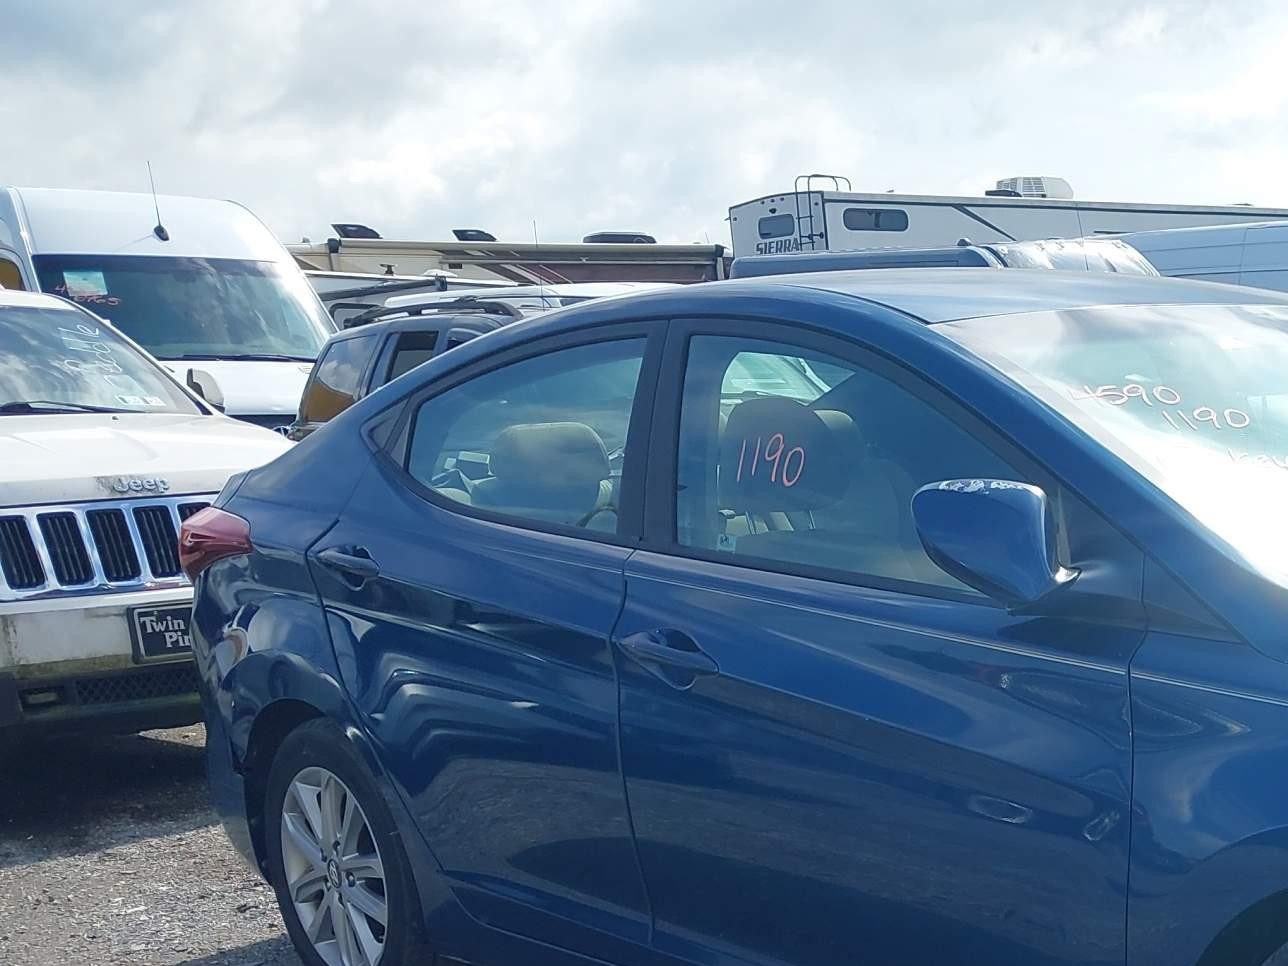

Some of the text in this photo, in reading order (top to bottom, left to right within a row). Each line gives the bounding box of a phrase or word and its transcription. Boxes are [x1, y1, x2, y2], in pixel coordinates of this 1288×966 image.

[756, 238, 800, 255] SIERRA
[1067, 383, 1181, 407] 4590
[1162, 406, 1250, 431] 1190
[736, 432, 805, 487] 1190
[113, 477, 169, 494] Jeep
[139, 615, 186, 633] Twin
